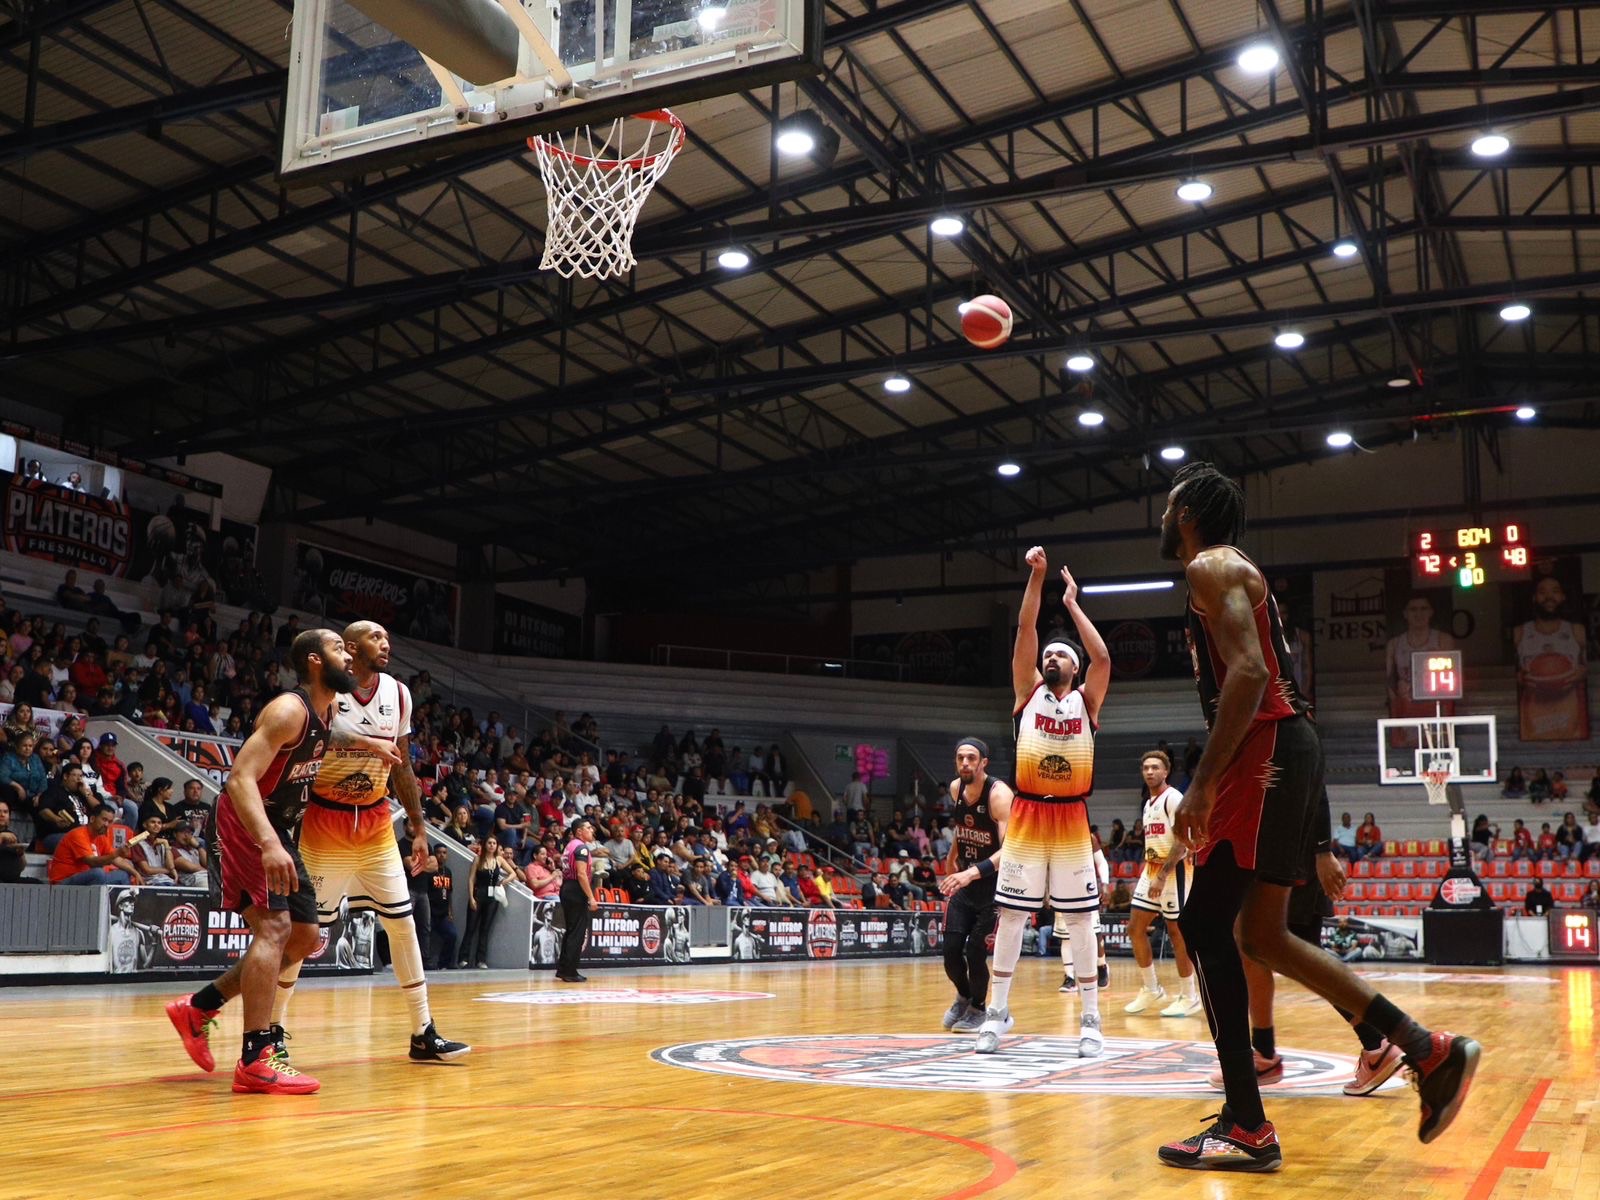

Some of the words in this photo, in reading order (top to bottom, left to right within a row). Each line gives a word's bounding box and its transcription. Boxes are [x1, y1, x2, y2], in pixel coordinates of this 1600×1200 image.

[8, 488, 129, 557] PLATEROS
[1420, 533, 1432, 549] 2
[1506, 525, 1518, 542] 0
[28, 537, 108, 566] FRESNILLO
[1465, 552, 1476, 569] 3
[1503, 547, 1527, 566] 48
[1419, 554, 1440, 572] 72
[328, 567, 409, 607] GUERREROS
[1430, 671, 1454, 692] 14
[1034, 713, 1083, 735] ROJOS
[1037, 771, 1073, 782] VERACRUZ
[965, 845, 978, 860] 24
[163, 923, 200, 937] PLATEROS
[807, 922, 837, 942] PLATEROS
[1567, 927, 1590, 948] 14
